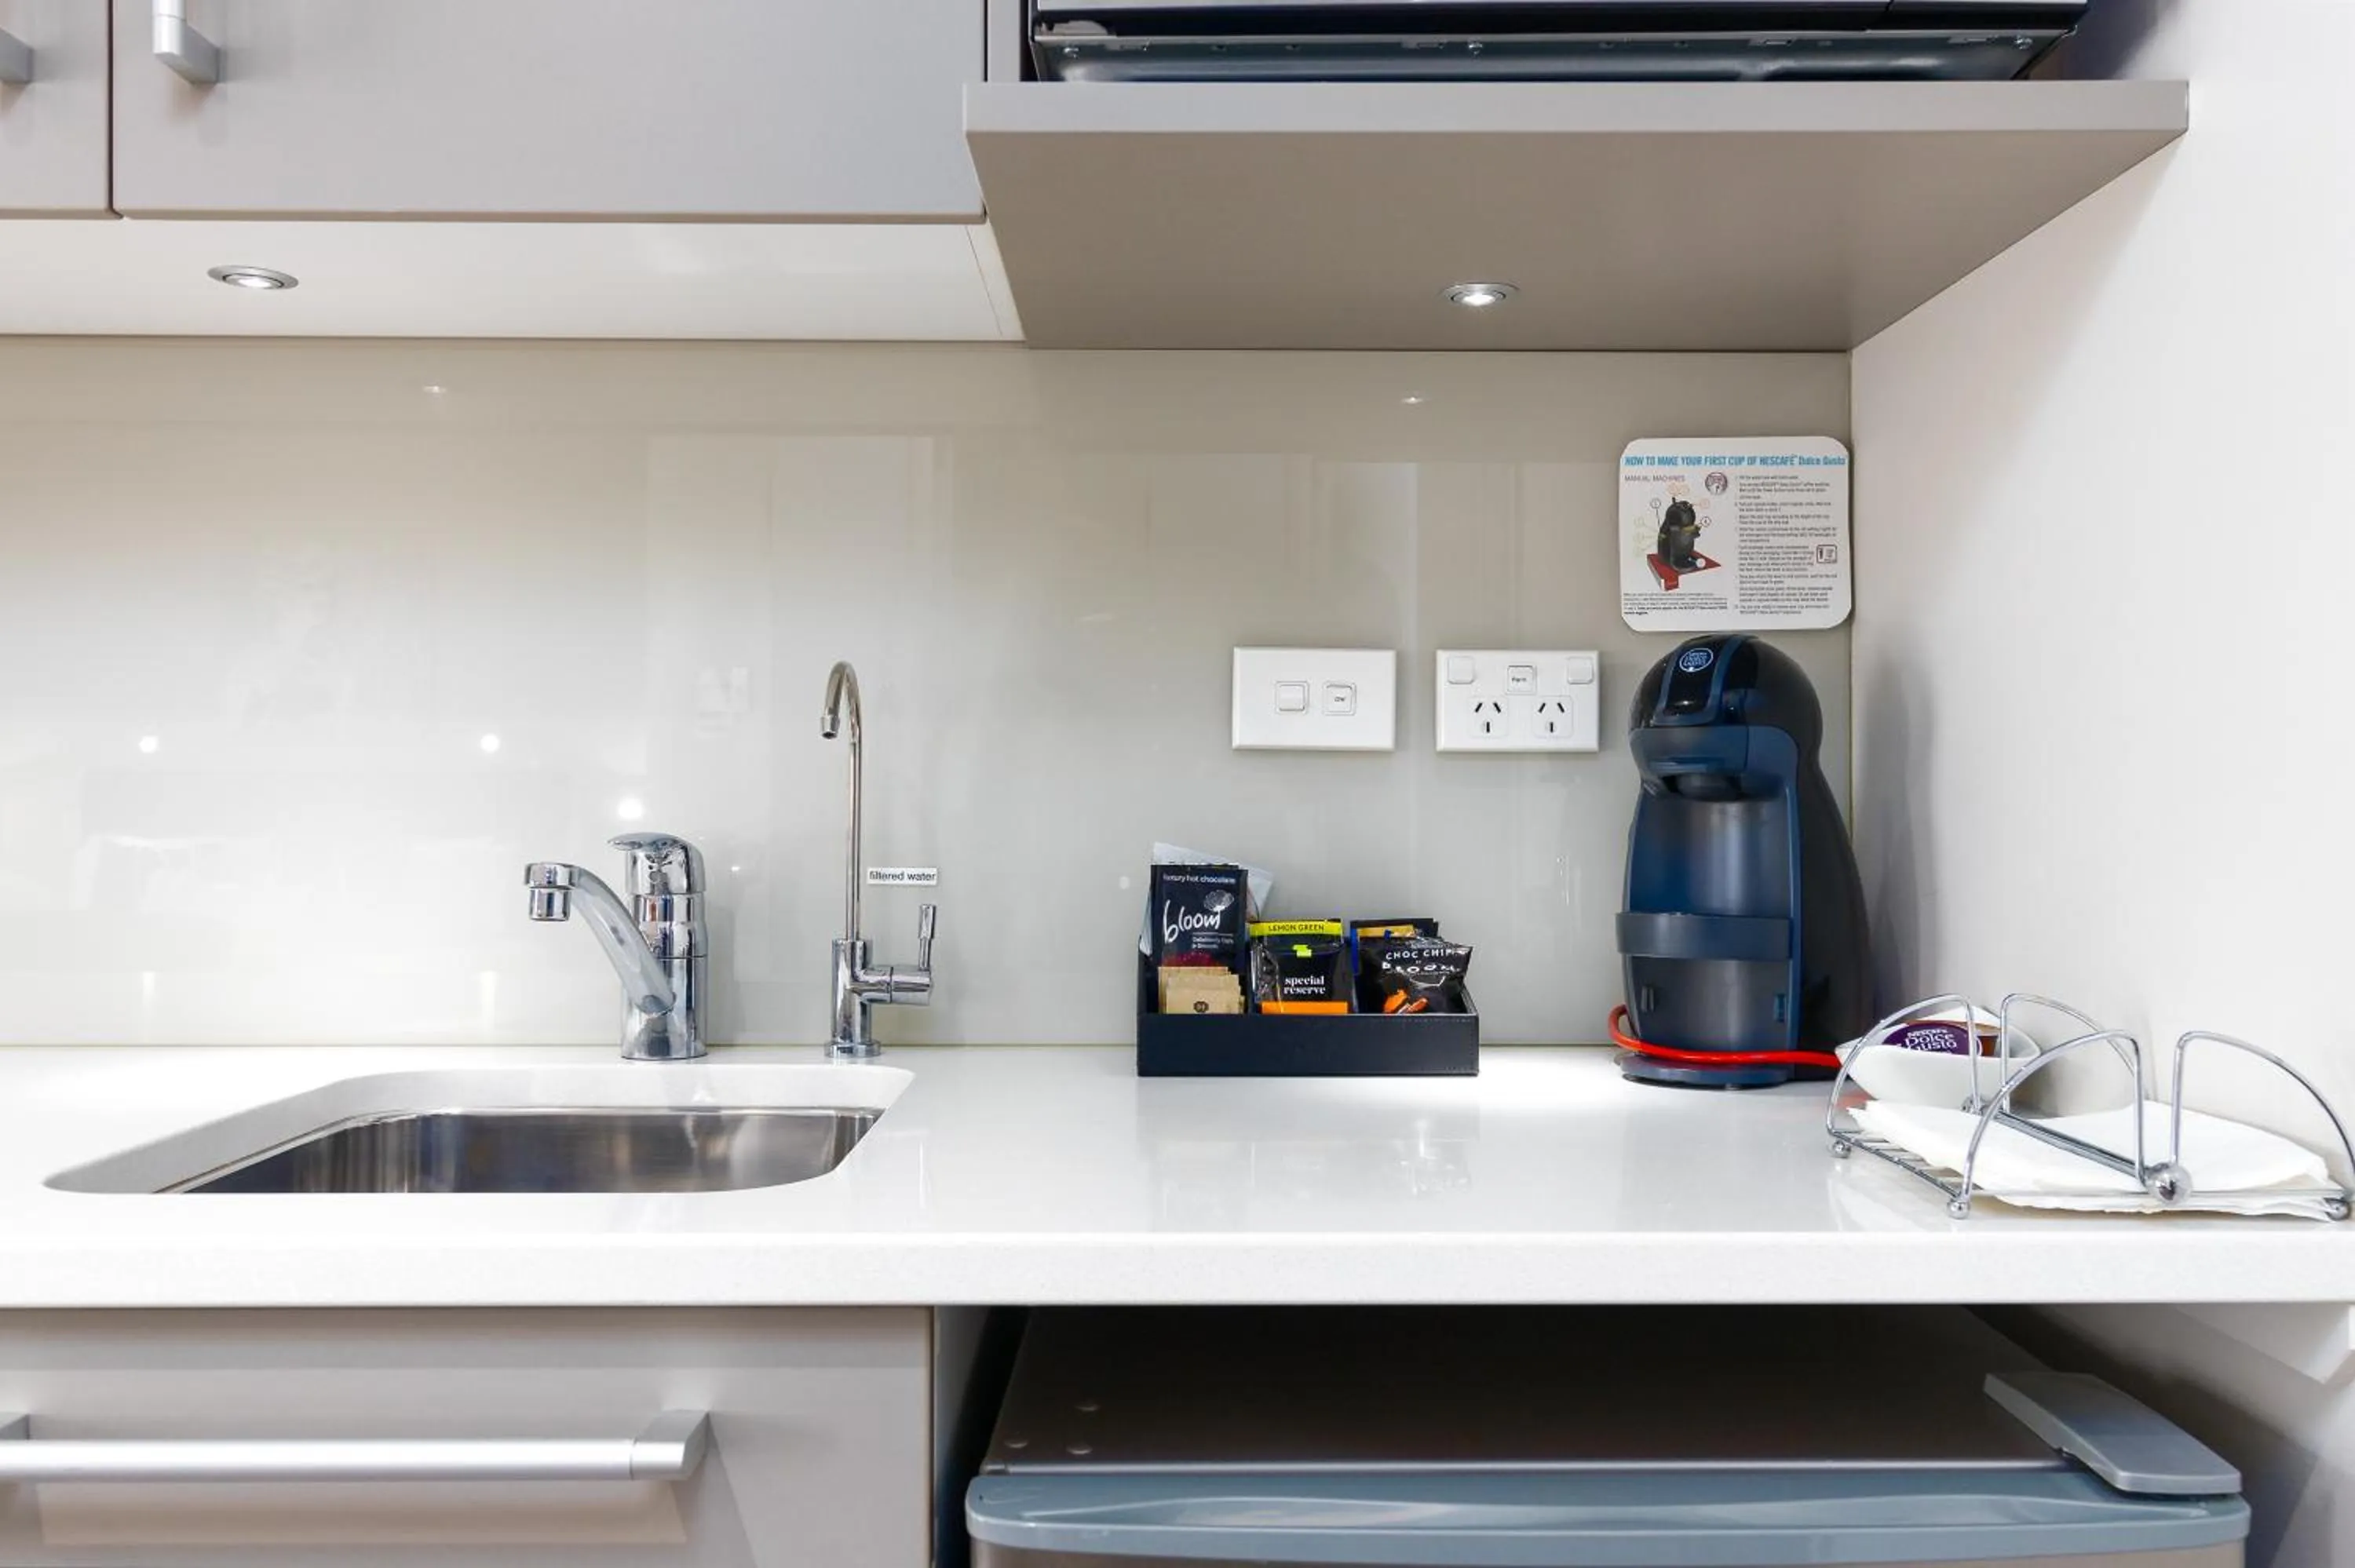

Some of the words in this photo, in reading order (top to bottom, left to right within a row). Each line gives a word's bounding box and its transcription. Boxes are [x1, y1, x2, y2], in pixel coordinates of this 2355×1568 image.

[1625, 456, 1644, 465] HOW
[1646, 456, 1656, 465] TO
[1657, 456, 1679, 465] MAKE
[1681, 456, 1702, 465] YOUR
[1703, 456, 1726, 465] FIRST
[1728, 456, 1744, 465] CUP
[1747, 456, 1758, 465] OF
[869, 870, 905, 881] filtered
[907, 872, 937, 881] water
[1163, 899, 1221, 944] bloom
[1385, 950, 1418, 960] CHOC
[1284, 975, 1325, 986] special
[1283, 986, 1326, 995] reserve
